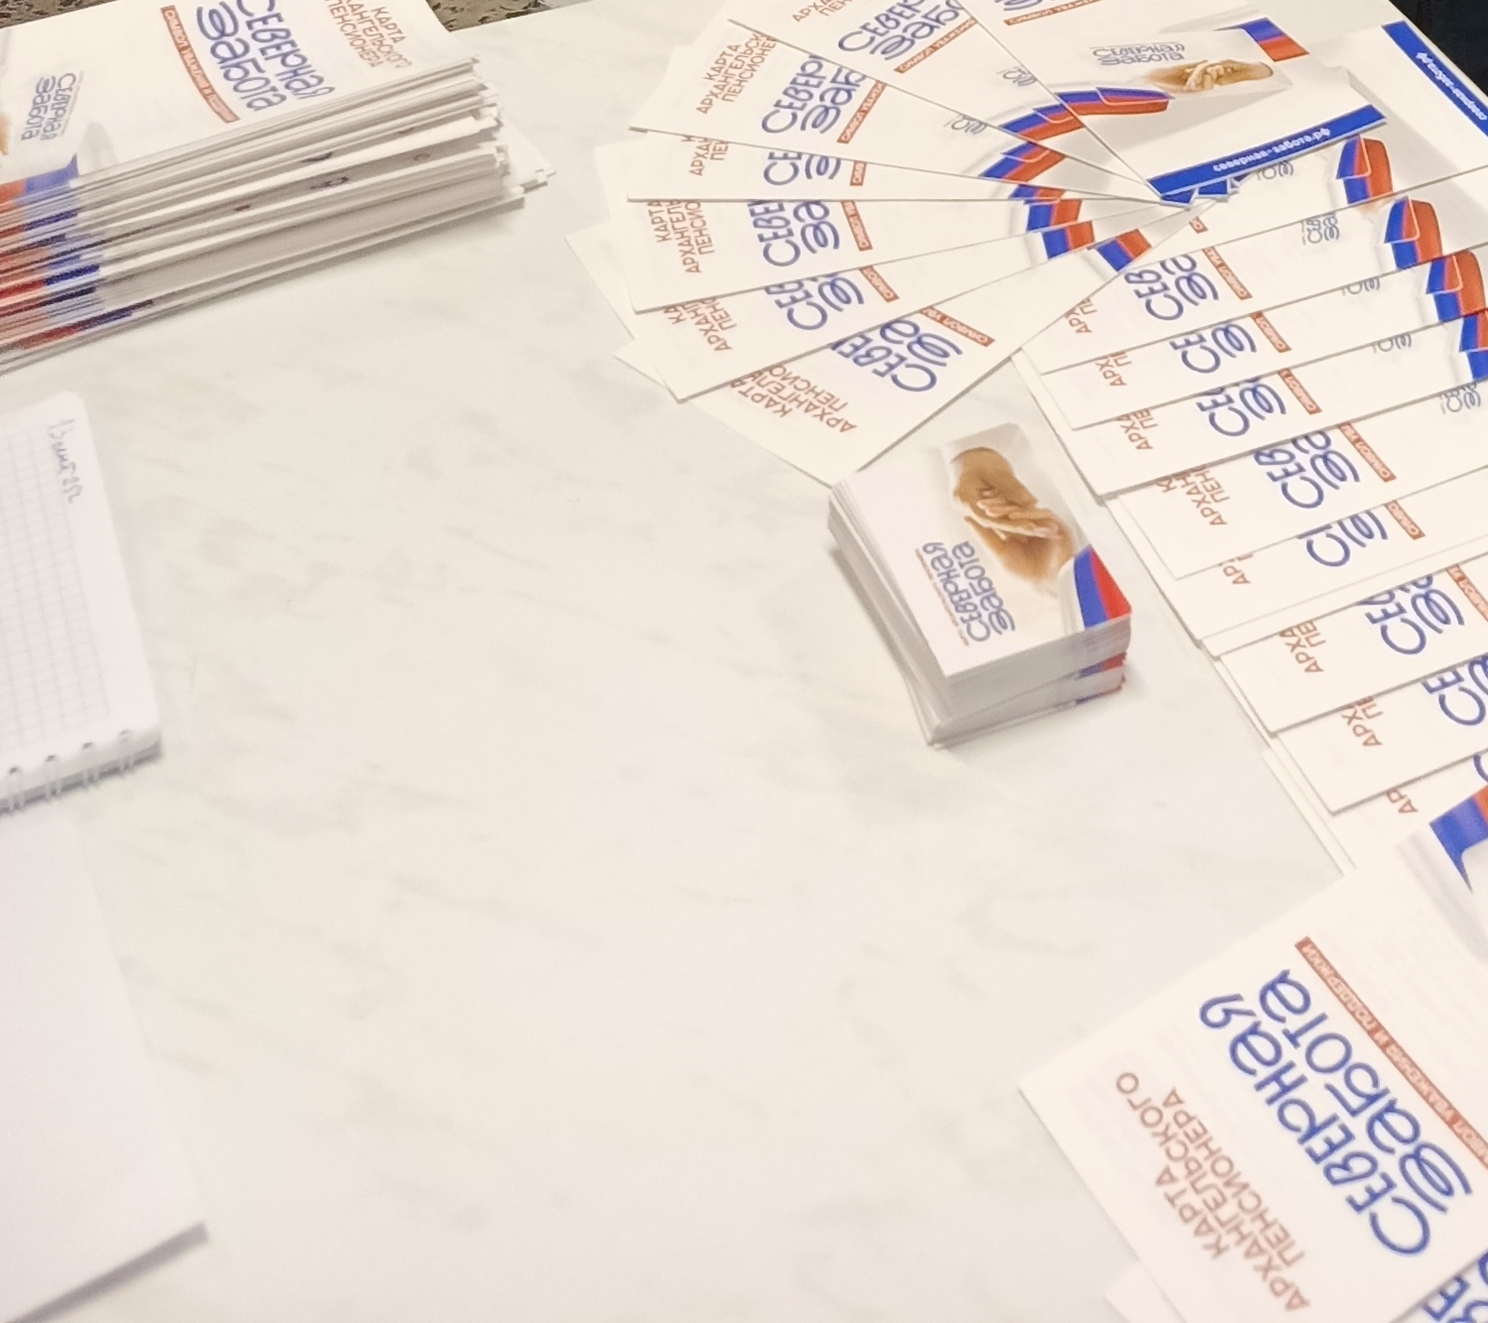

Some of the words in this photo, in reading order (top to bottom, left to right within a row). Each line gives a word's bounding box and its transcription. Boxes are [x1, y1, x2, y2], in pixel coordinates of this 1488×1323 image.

[371, 6, 406, 43] КАРТА
[703, 44, 741, 81] КАРТА
[1162, 1087, 1306, 1267] ПЕНСИОНЕРА
[1199, 993, 1431, 1256] СЕВЕРНАЯ
[1258, 968, 1474, 1213] ЗАБОТА
[1115, 1071, 1311, 1313] АРХАНГЕЛЬСКОГО
[1155, 1164, 1230, 1260] КАРТА
